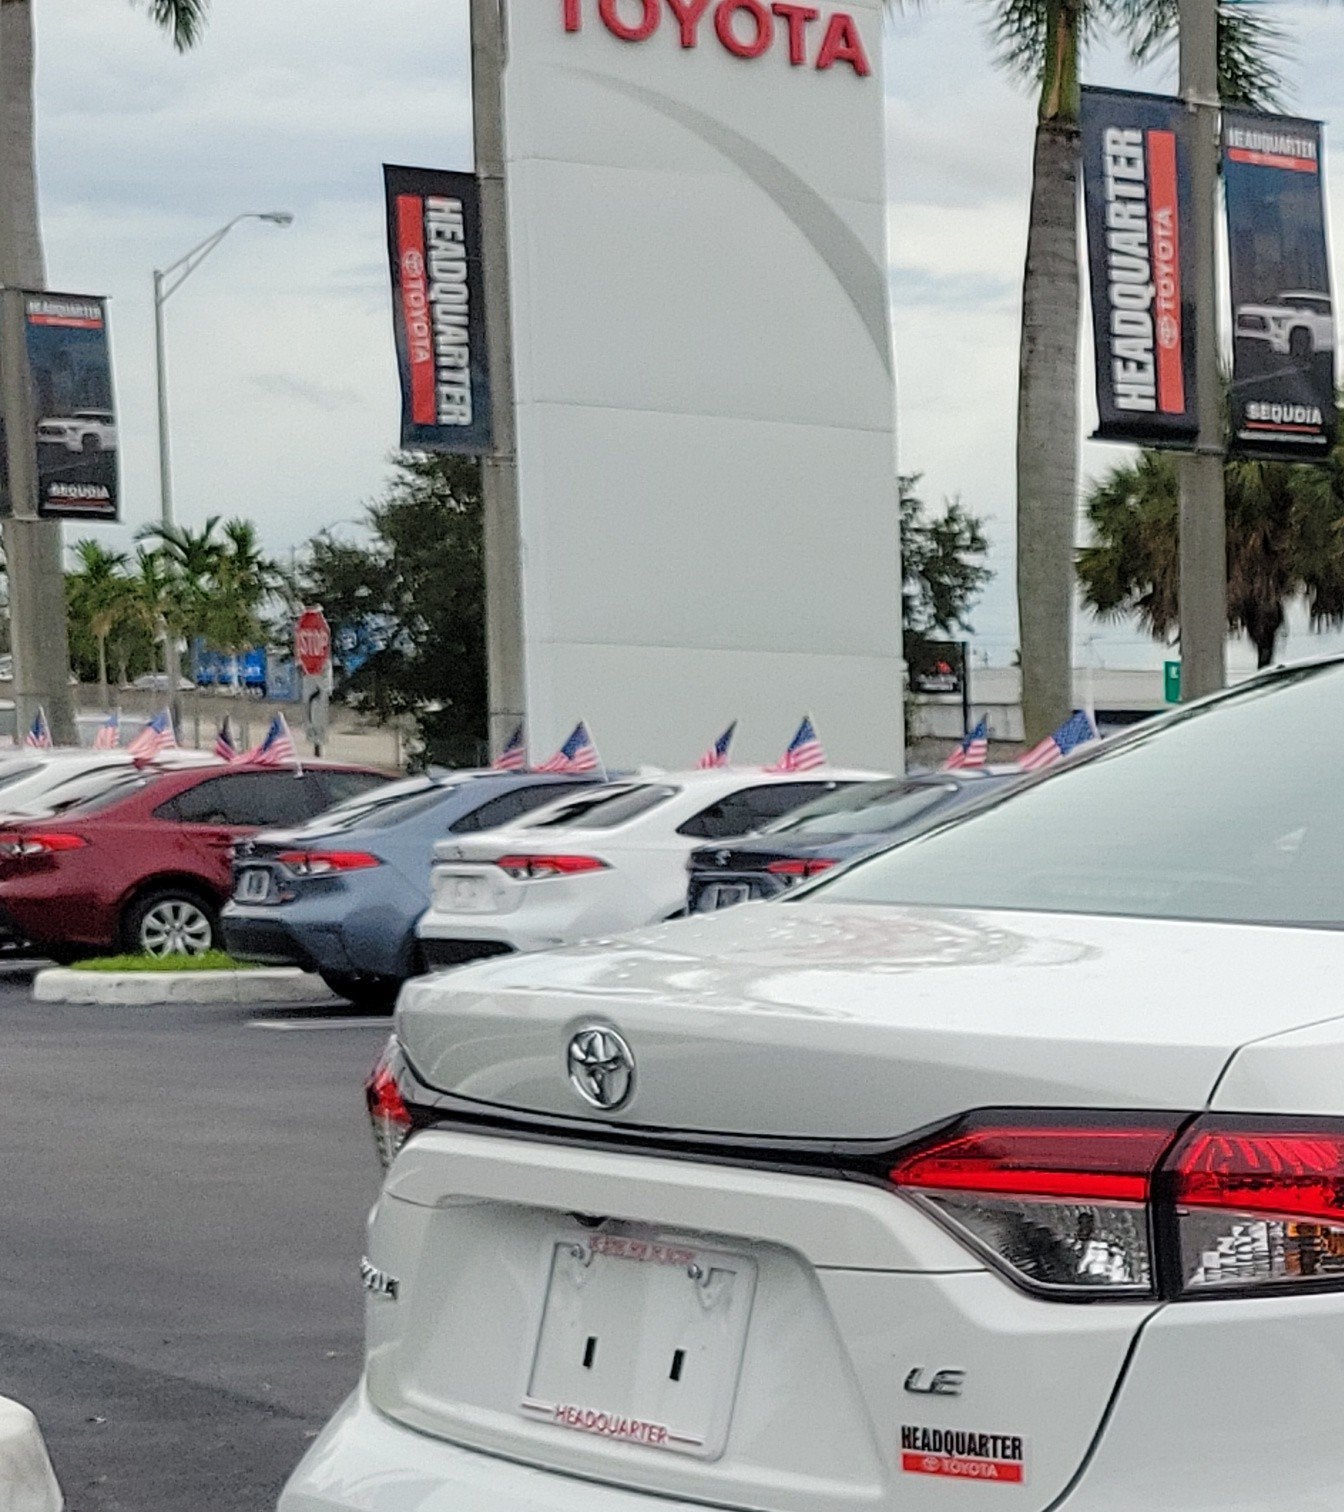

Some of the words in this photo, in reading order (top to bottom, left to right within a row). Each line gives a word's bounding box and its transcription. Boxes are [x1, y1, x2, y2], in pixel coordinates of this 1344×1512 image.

[1102, 127, 1157, 413] HEADQUARTER
[1153, 208, 1177, 310] TOYOTA
[402, 276, 432, 364] TOYOTA
[425, 195, 473, 427] HEADQUARTER
[1245, 401, 1323, 425] SEQUOIA
[299, 629, 330, 656] STOP
[903, 1367, 967, 1396] LE
[554, 1404, 669, 1444] HEADQUARTER
[901, 1424, 1023, 1461] HEADQUARTER
[942, 1458, 999, 1478] TOYOTA
